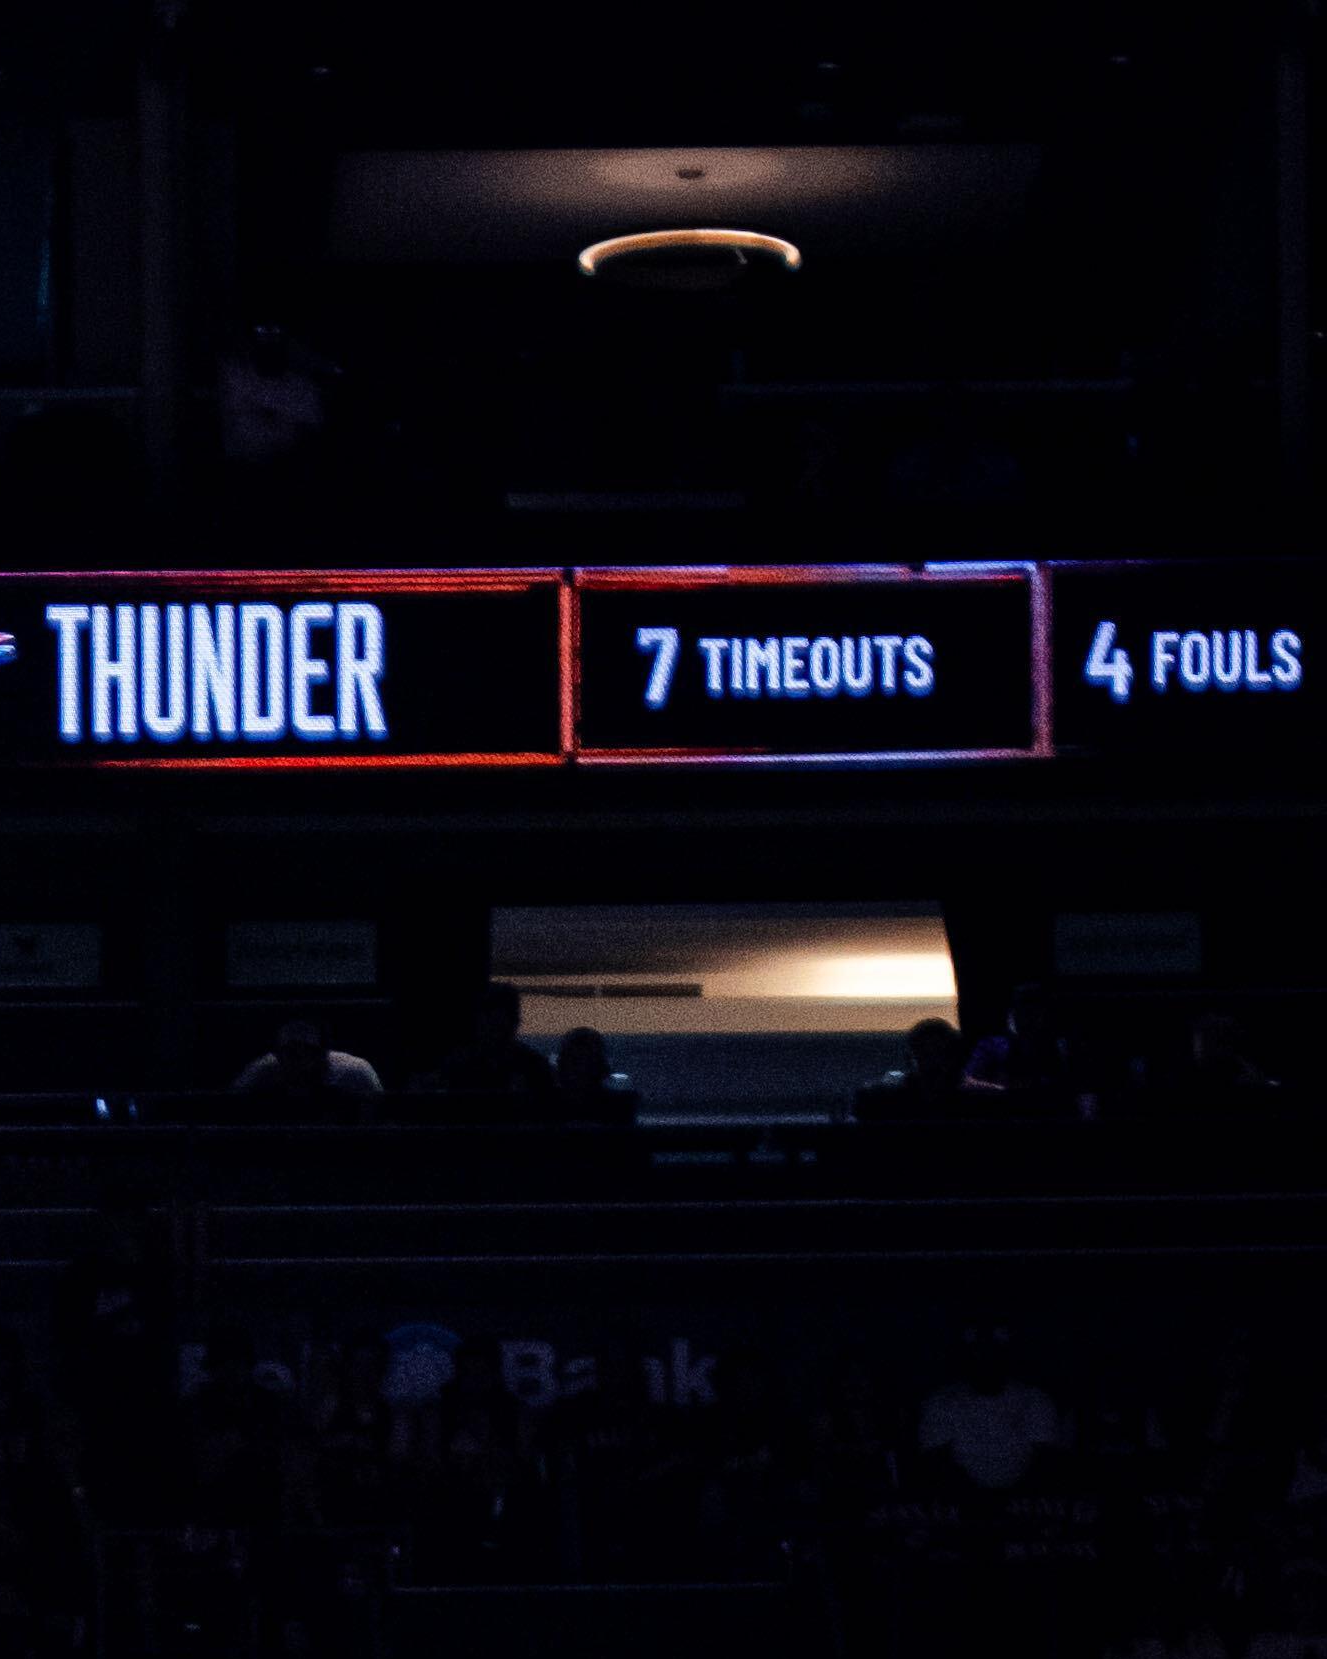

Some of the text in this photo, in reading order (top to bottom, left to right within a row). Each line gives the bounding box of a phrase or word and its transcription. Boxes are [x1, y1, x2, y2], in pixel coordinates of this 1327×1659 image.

[46, 603, 387, 738] THUNDER
[636, 627, 934, 706] 7 TIMEOUTS
[1085, 621, 1302, 701] 4 FOULS
